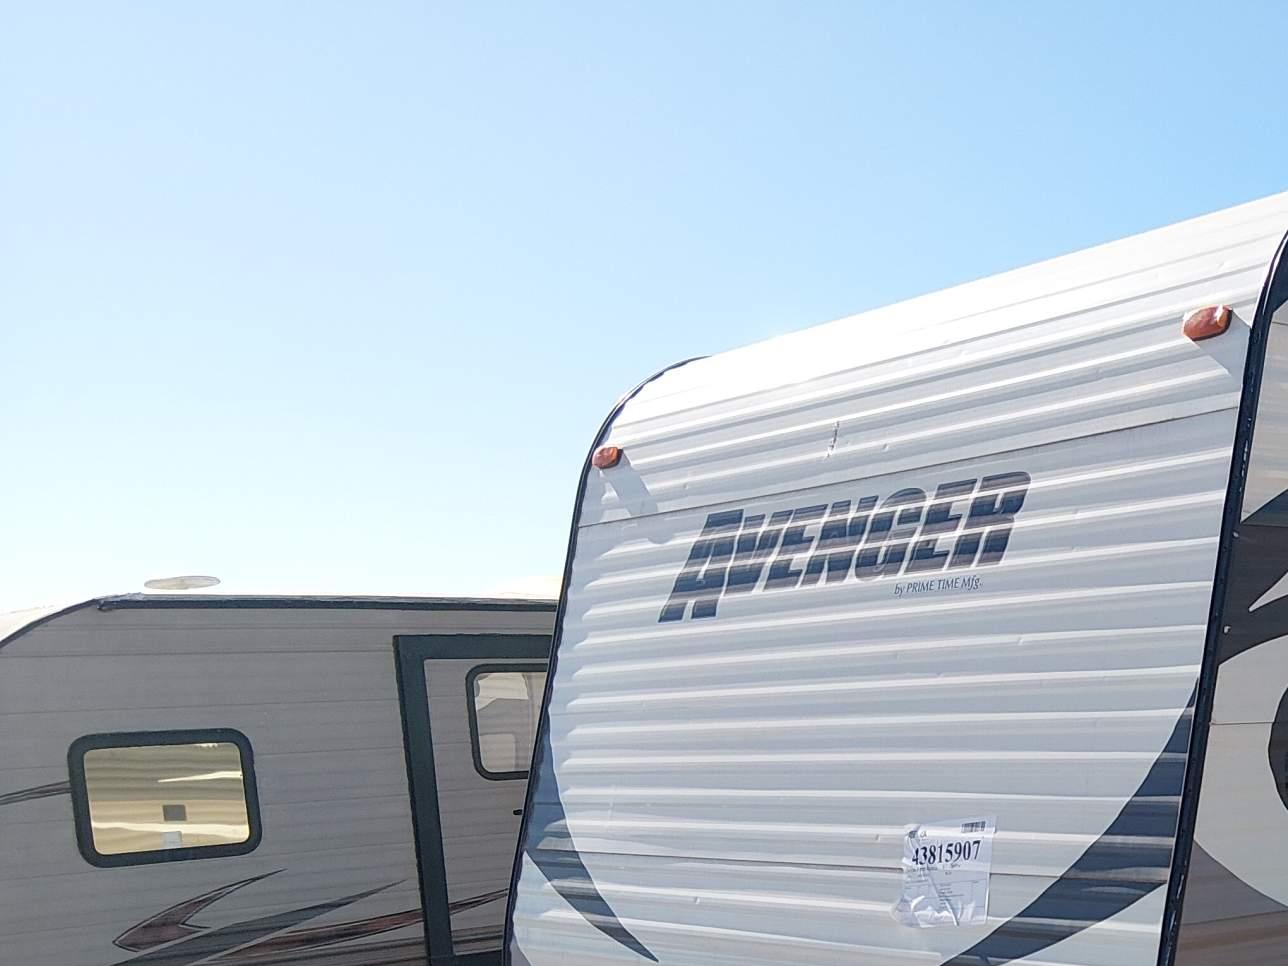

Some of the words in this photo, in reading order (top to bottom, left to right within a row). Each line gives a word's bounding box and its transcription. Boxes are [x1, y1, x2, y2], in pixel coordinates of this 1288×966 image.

[659, 471, 1031, 622] AVENGER
[894, 582, 905, 598] by
[906, 580, 934, 593] PRIME
[937, 577, 960, 590] TIME
[912, 840, 981, 866] 43815907
